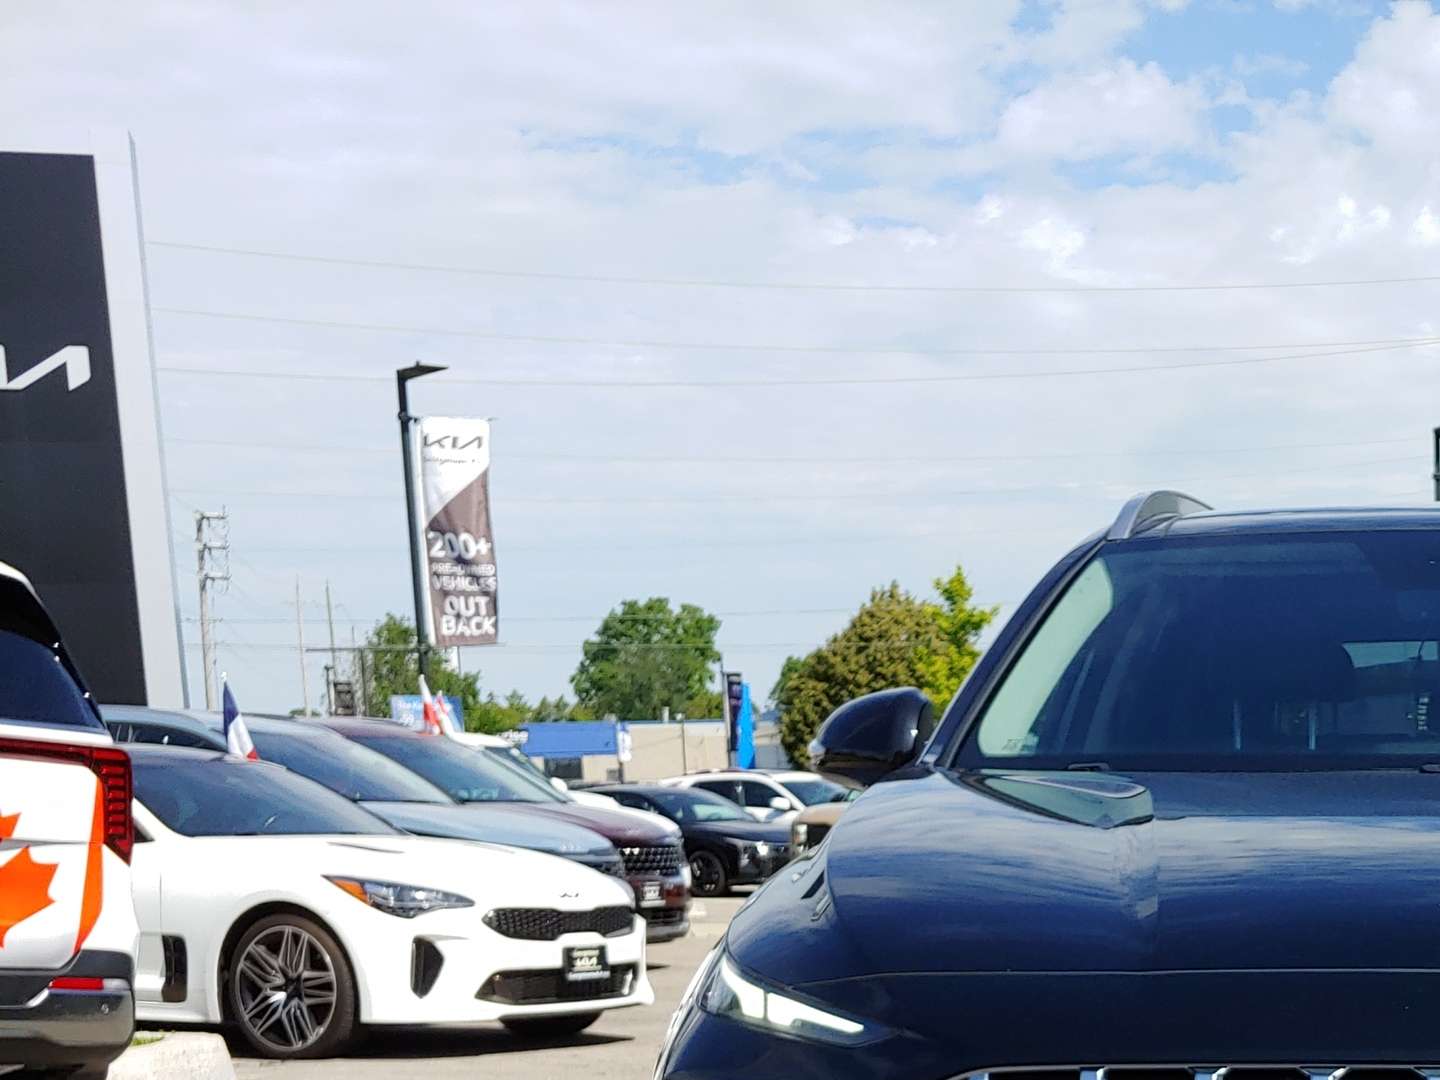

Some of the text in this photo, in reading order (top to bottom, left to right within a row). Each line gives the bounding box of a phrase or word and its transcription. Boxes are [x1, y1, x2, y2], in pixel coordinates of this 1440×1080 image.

[423, 434, 483, 449] KIA
[427, 532, 491, 560] 200+
[444, 595, 490, 617] OUT
[442, 615, 496, 637] BACK
